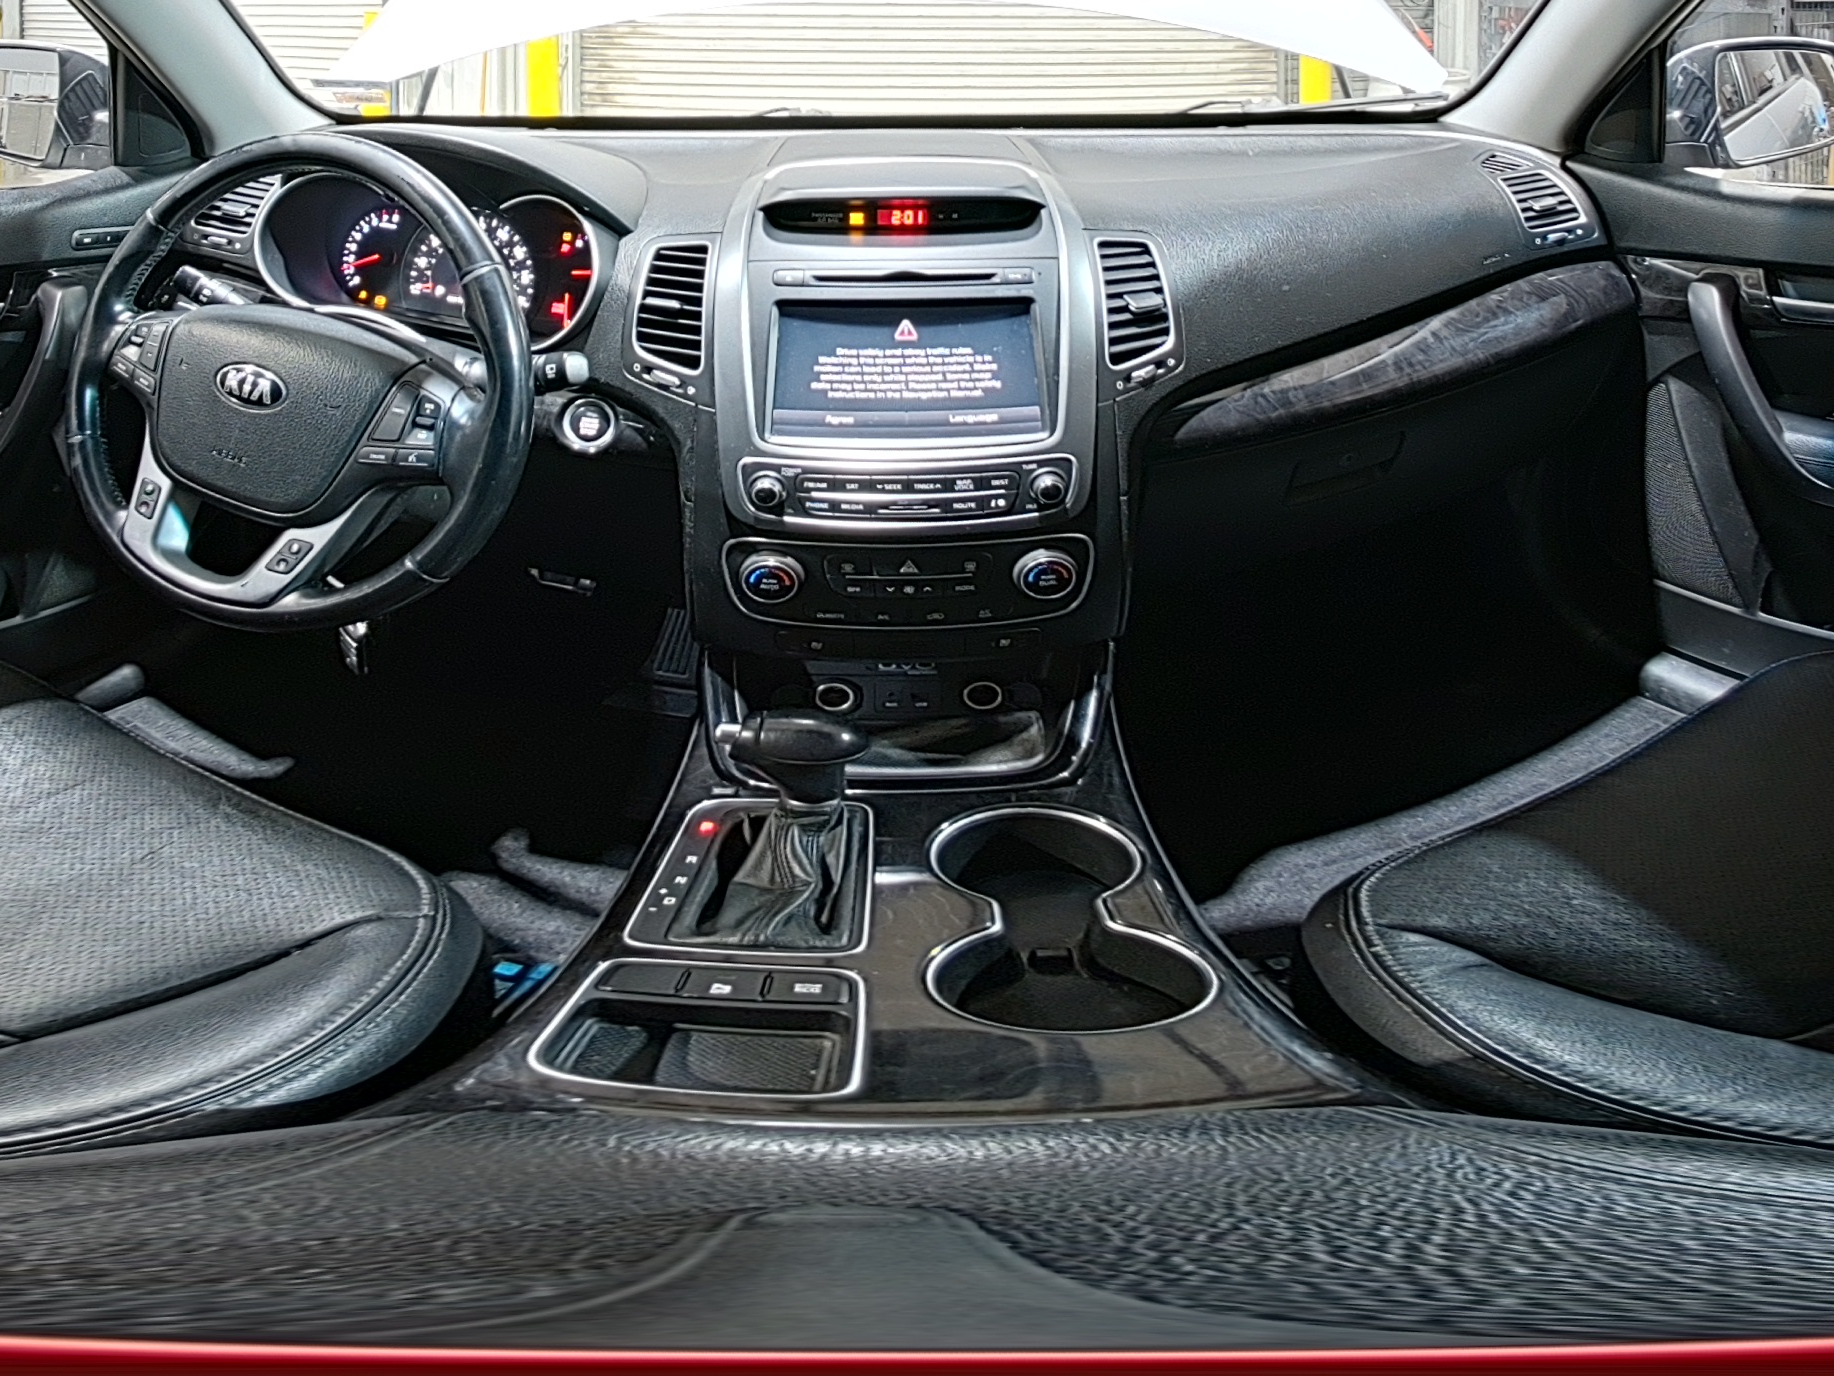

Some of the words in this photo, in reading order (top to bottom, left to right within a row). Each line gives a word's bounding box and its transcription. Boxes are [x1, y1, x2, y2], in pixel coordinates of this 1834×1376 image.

[891, 209, 924, 224] 2:01
[223, 368, 272, 405] KIA
[825, 415, 854, 424] Agree
[949, 413, 998, 424] Language
[805, 501, 829, 509] PHONE
[840, 503, 864, 511] MEDIA
[685, 855, 699, 864] R
[674, 875, 688, 884] N
